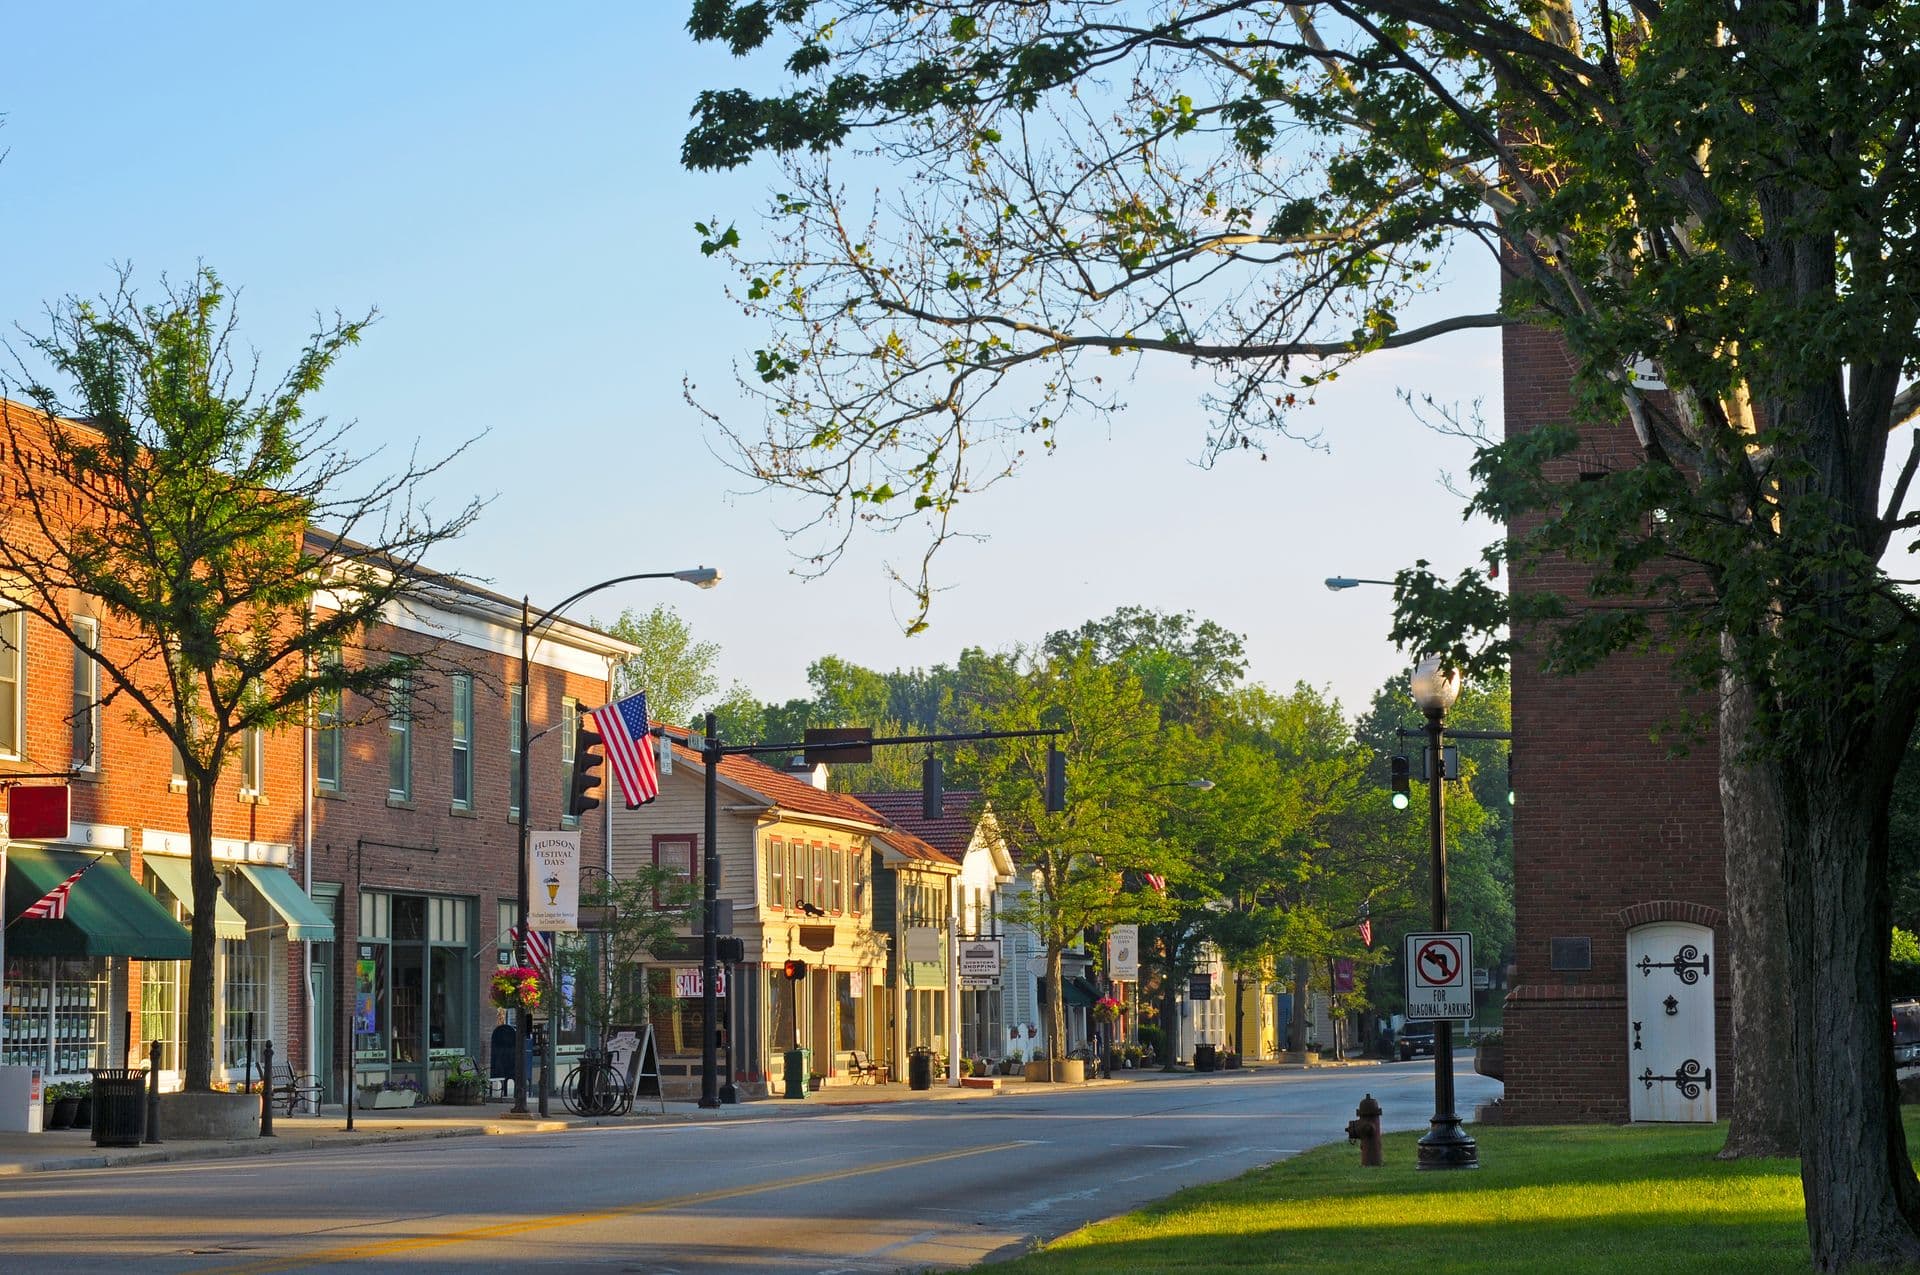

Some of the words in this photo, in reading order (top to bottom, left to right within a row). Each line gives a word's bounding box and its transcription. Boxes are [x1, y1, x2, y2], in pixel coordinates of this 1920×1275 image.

[535, 839, 575, 851] HUDSON
[677, 976, 703, 996] SALE
[1433, 990, 1446, 1001] FOR
[1409, 1003, 1441, 1016] DIAGONAL
[1443, 1002, 1471, 1016] PARKING
